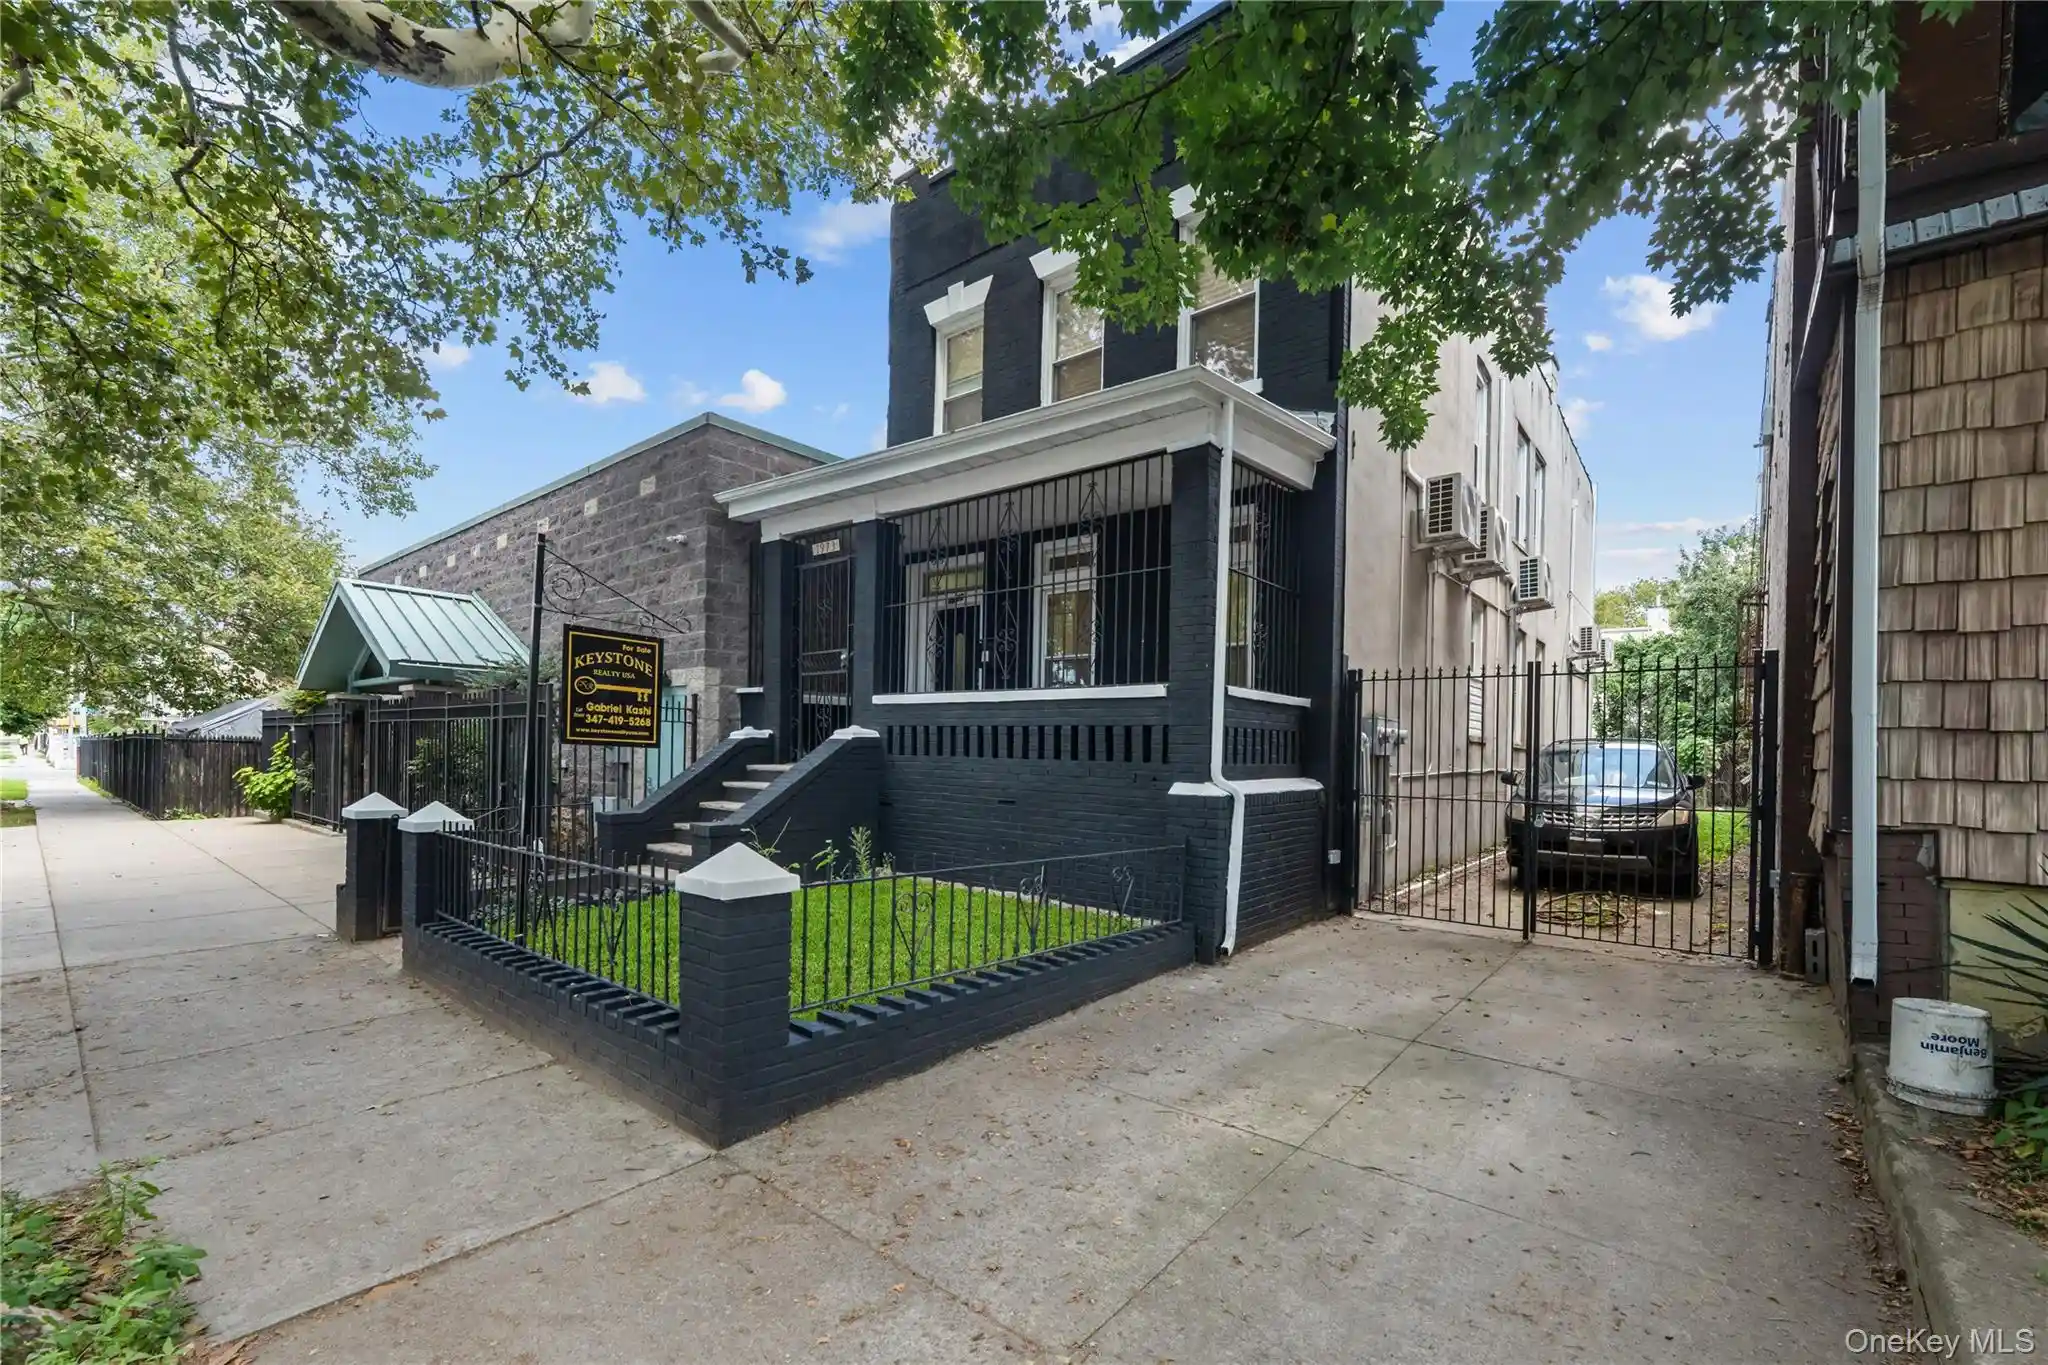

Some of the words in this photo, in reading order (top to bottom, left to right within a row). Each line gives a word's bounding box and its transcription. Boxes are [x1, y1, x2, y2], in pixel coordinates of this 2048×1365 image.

[636, 646, 652, 654] Sale
[574, 651, 653, 678] KEYSTONE
[593, 669, 620, 678] REALTY
[622, 671, 635, 679] USA
[586, 701, 622, 714] Gabriel
[626, 705, 651, 716] Kashi
[585, 714, 651, 727] 347-419-5268
[1930, 1032, 1980, 1048] Moore
[1920, 1041, 1988, 1059] Benjamin
